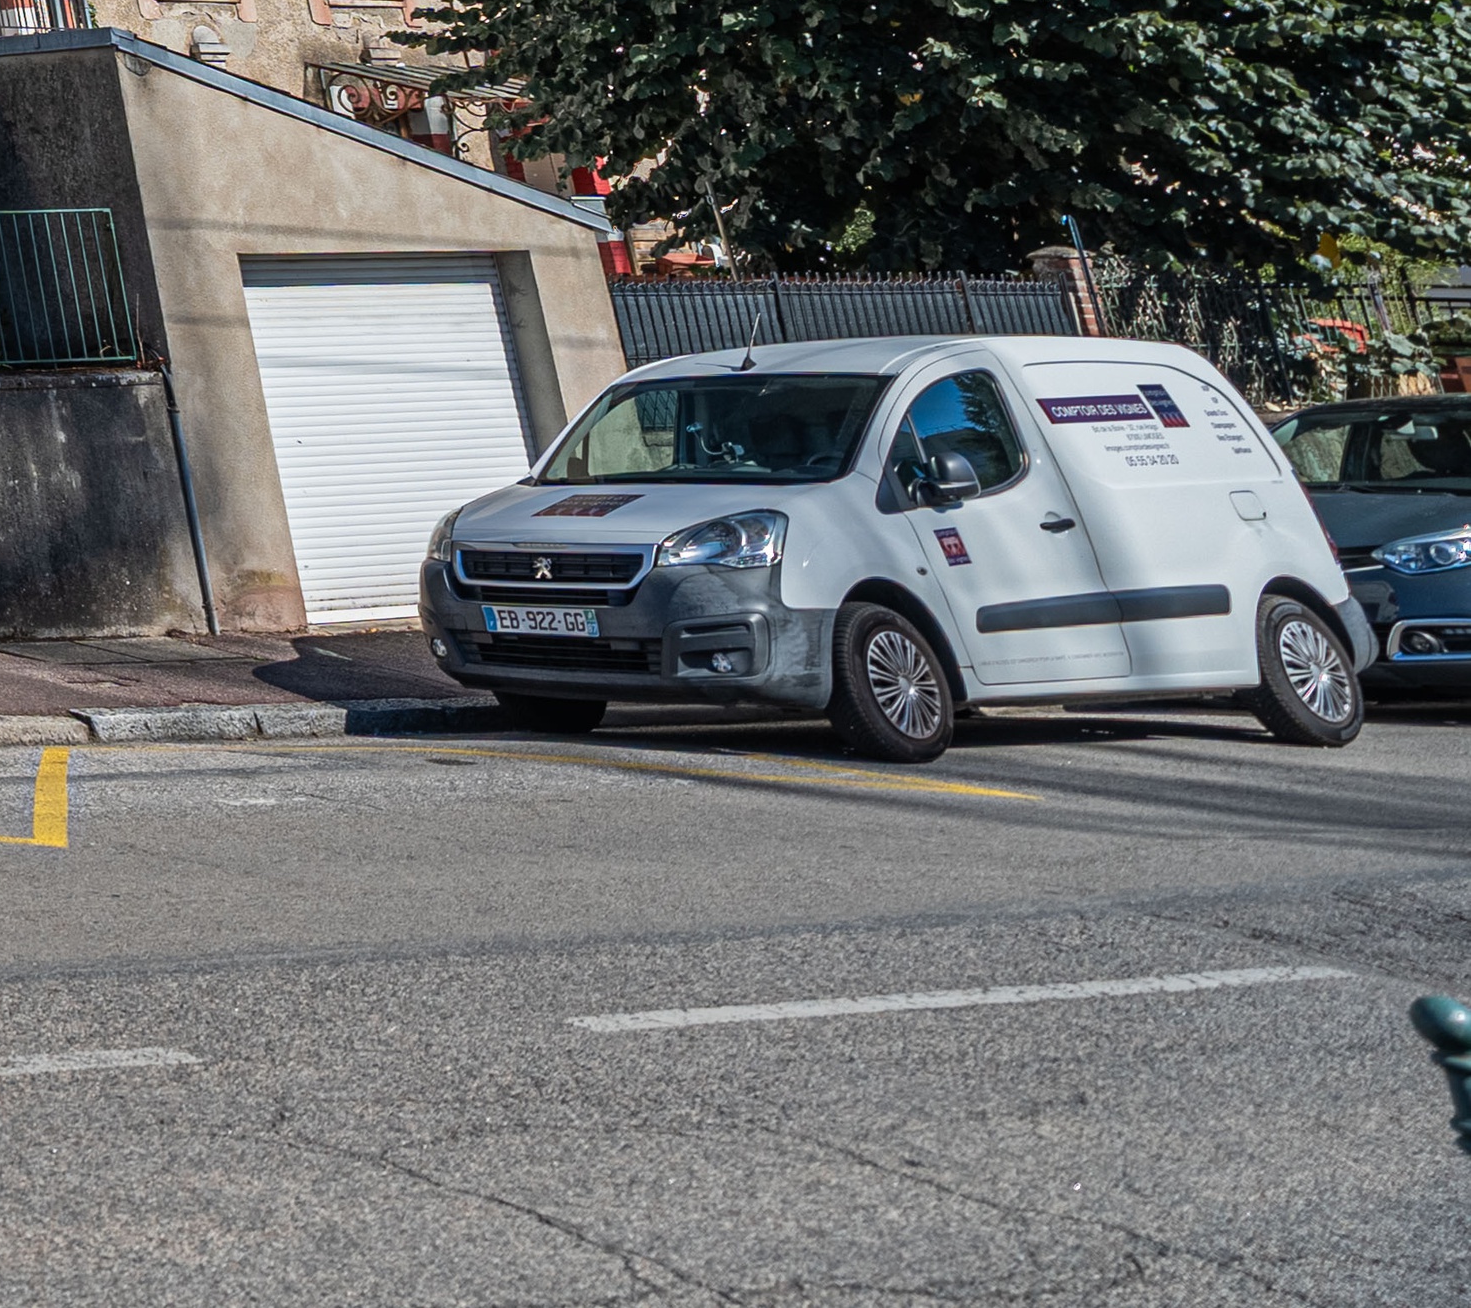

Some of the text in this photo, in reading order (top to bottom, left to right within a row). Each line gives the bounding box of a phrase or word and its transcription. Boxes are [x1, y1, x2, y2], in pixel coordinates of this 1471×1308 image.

[1051, 403, 1147, 417] COMPTOIR DES VIGNES
[497, 610, 585, 632] EB-922-GG
